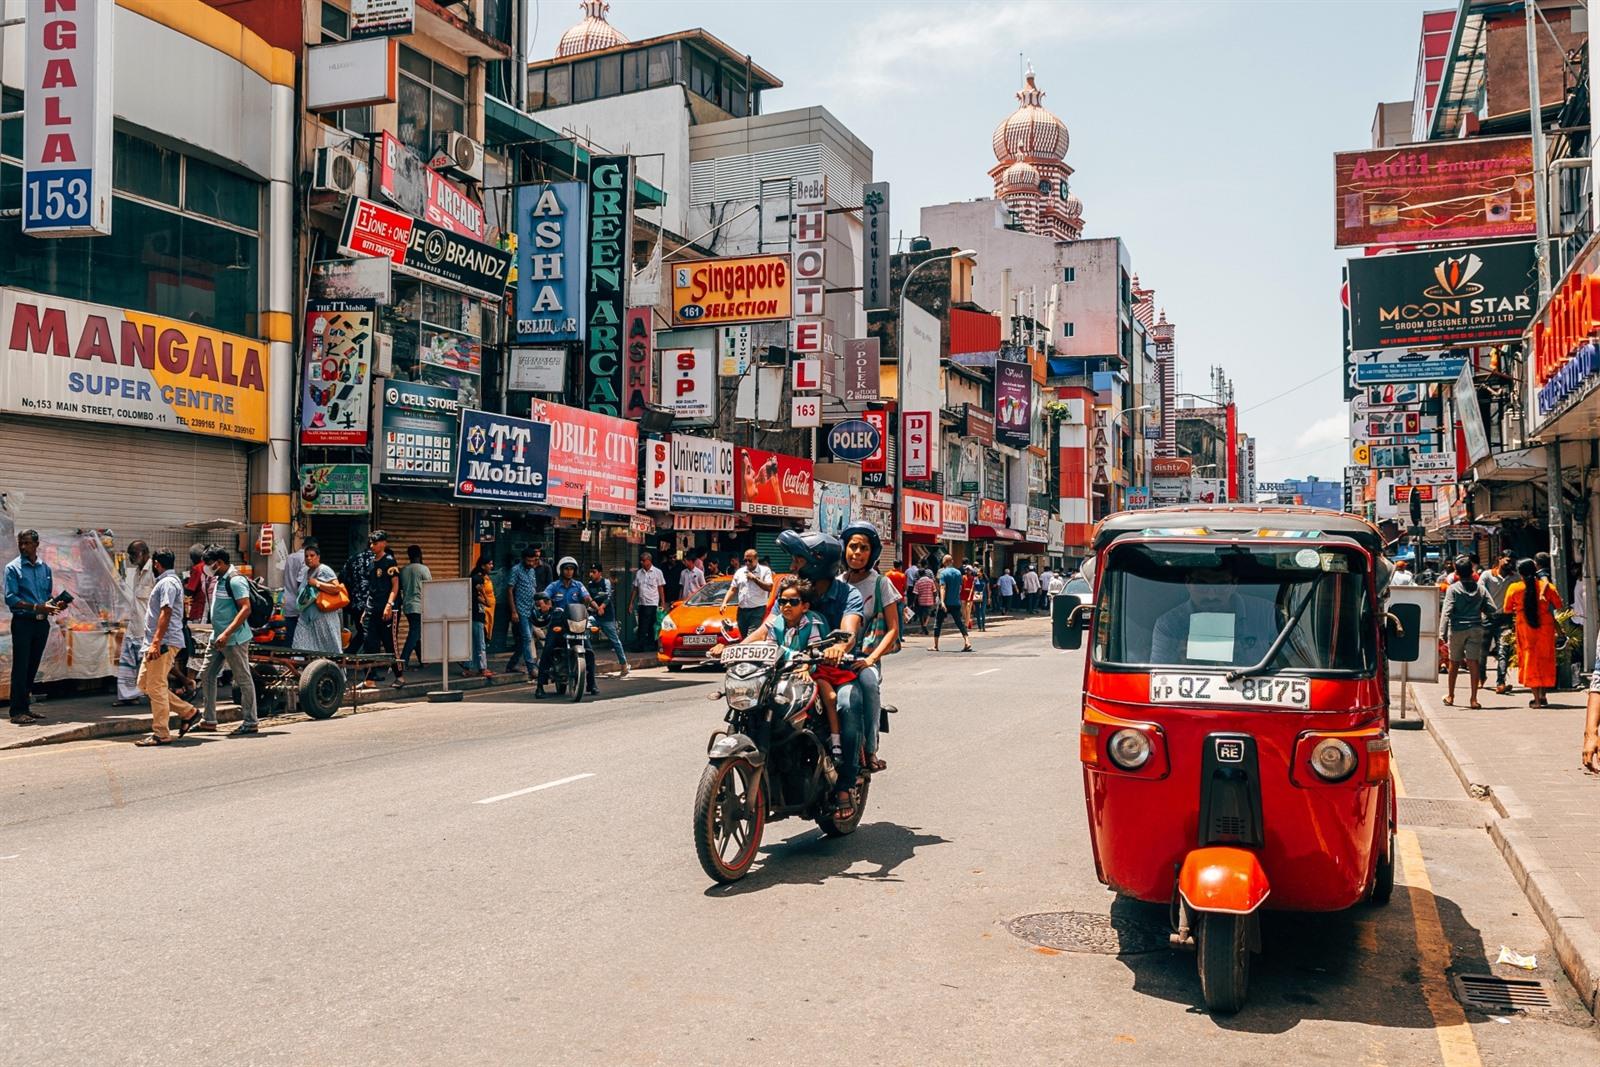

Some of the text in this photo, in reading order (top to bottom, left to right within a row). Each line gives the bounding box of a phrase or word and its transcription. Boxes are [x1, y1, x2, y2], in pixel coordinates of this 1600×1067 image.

[431, 156, 447, 169] 155
[1352, 153, 1430, 181] Aadil
[29, 177, 88, 221] 153
[437, 181, 481, 237] ARCADE
[370, 219, 388, 237] ONE
[392, 226, 410, 244] ONE
[591, 164, 623, 292] GREEN
[445, 242, 506, 280] BRANDZ
[532, 190, 564, 312] ASHA
[691, 262, 785, 303] Singapore
[331, 302, 346, 312] TT
[683, 300, 778, 319] 161 SELECTION
[797, 213, 823, 388] HOTEL
[1379, 295, 1531, 322] MOON STAR
[1395, 314, 1514, 331] GROOM DESIGNER (PVT) LTD
[8, 302, 265, 392] MANGALA
[628, 317, 649, 411] ASHA
[856, 351, 868, 389] POLEK
[68, 372, 235, 415] SUPER CENTRE
[401, 393, 426, 407] CELL
[427, 396, 458, 411] STORE
[846, 390, 854, 400] 2
[56, 402, 78, 413] MAIN
[81, 404, 114, 418] STREET,
[117, 408, 154, 421] COLOMBO
[176, 416, 189, 426] TEL:
[534, 403, 547, 416] MC
[796, 404, 815, 416] 163
[488, 423, 531, 464] TT
[551, 417, 637, 466] OBILE CITY
[833, 431, 873, 450] POLEK
[910, 418, 923, 460] DSI
[672, 441, 717, 475] Univercell
[720, 447, 732, 476] OG
[1154, 463, 1184, 472] dishtv
[467, 460, 543, 486] Mobile
[564, 480, 586, 490] SONY
[463, 484, 474, 492] 155
[1129, 496, 1148, 504] BEST
[748, 503, 789, 516] BEE BEE
[913, 501, 935, 523] DSI
[1178, 677, 1211, 699] QZ
[1241, 678, 1306, 704] 8075
[1220, 747, 1239, 758] RE
